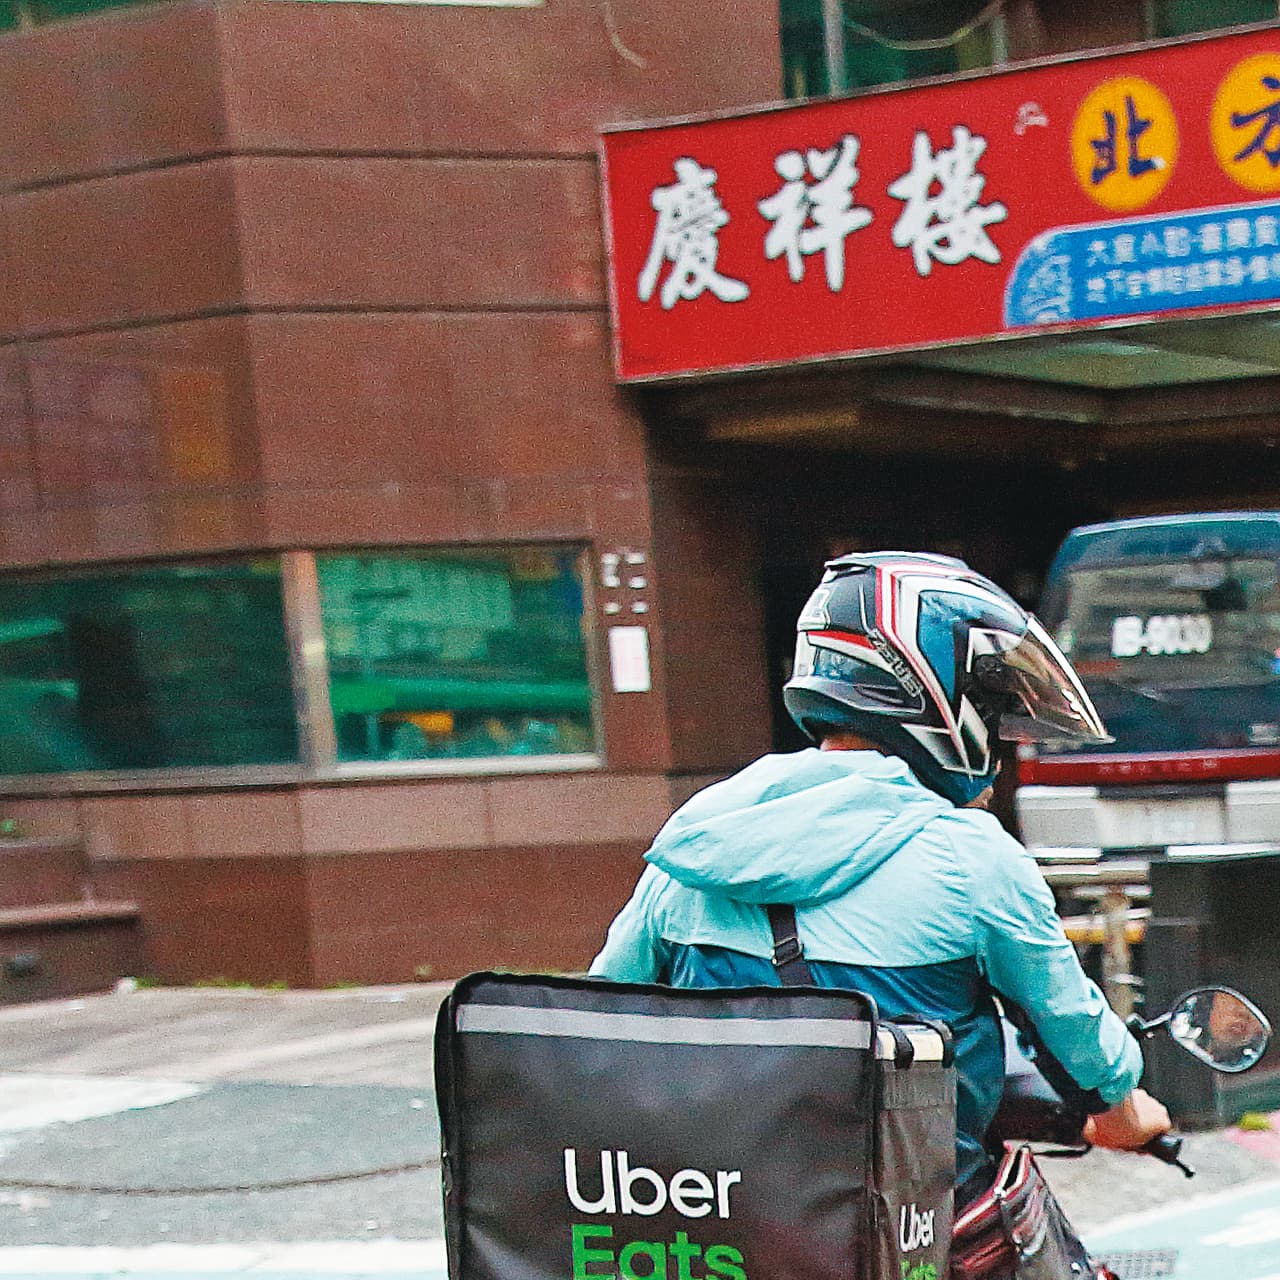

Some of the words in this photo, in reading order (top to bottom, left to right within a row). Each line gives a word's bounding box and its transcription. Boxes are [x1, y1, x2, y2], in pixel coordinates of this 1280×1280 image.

[637, 124, 1008, 310] 慶祥樓
[562, 1148, 742, 1219] Uber
[900, 1202, 935, 1253] Uber
